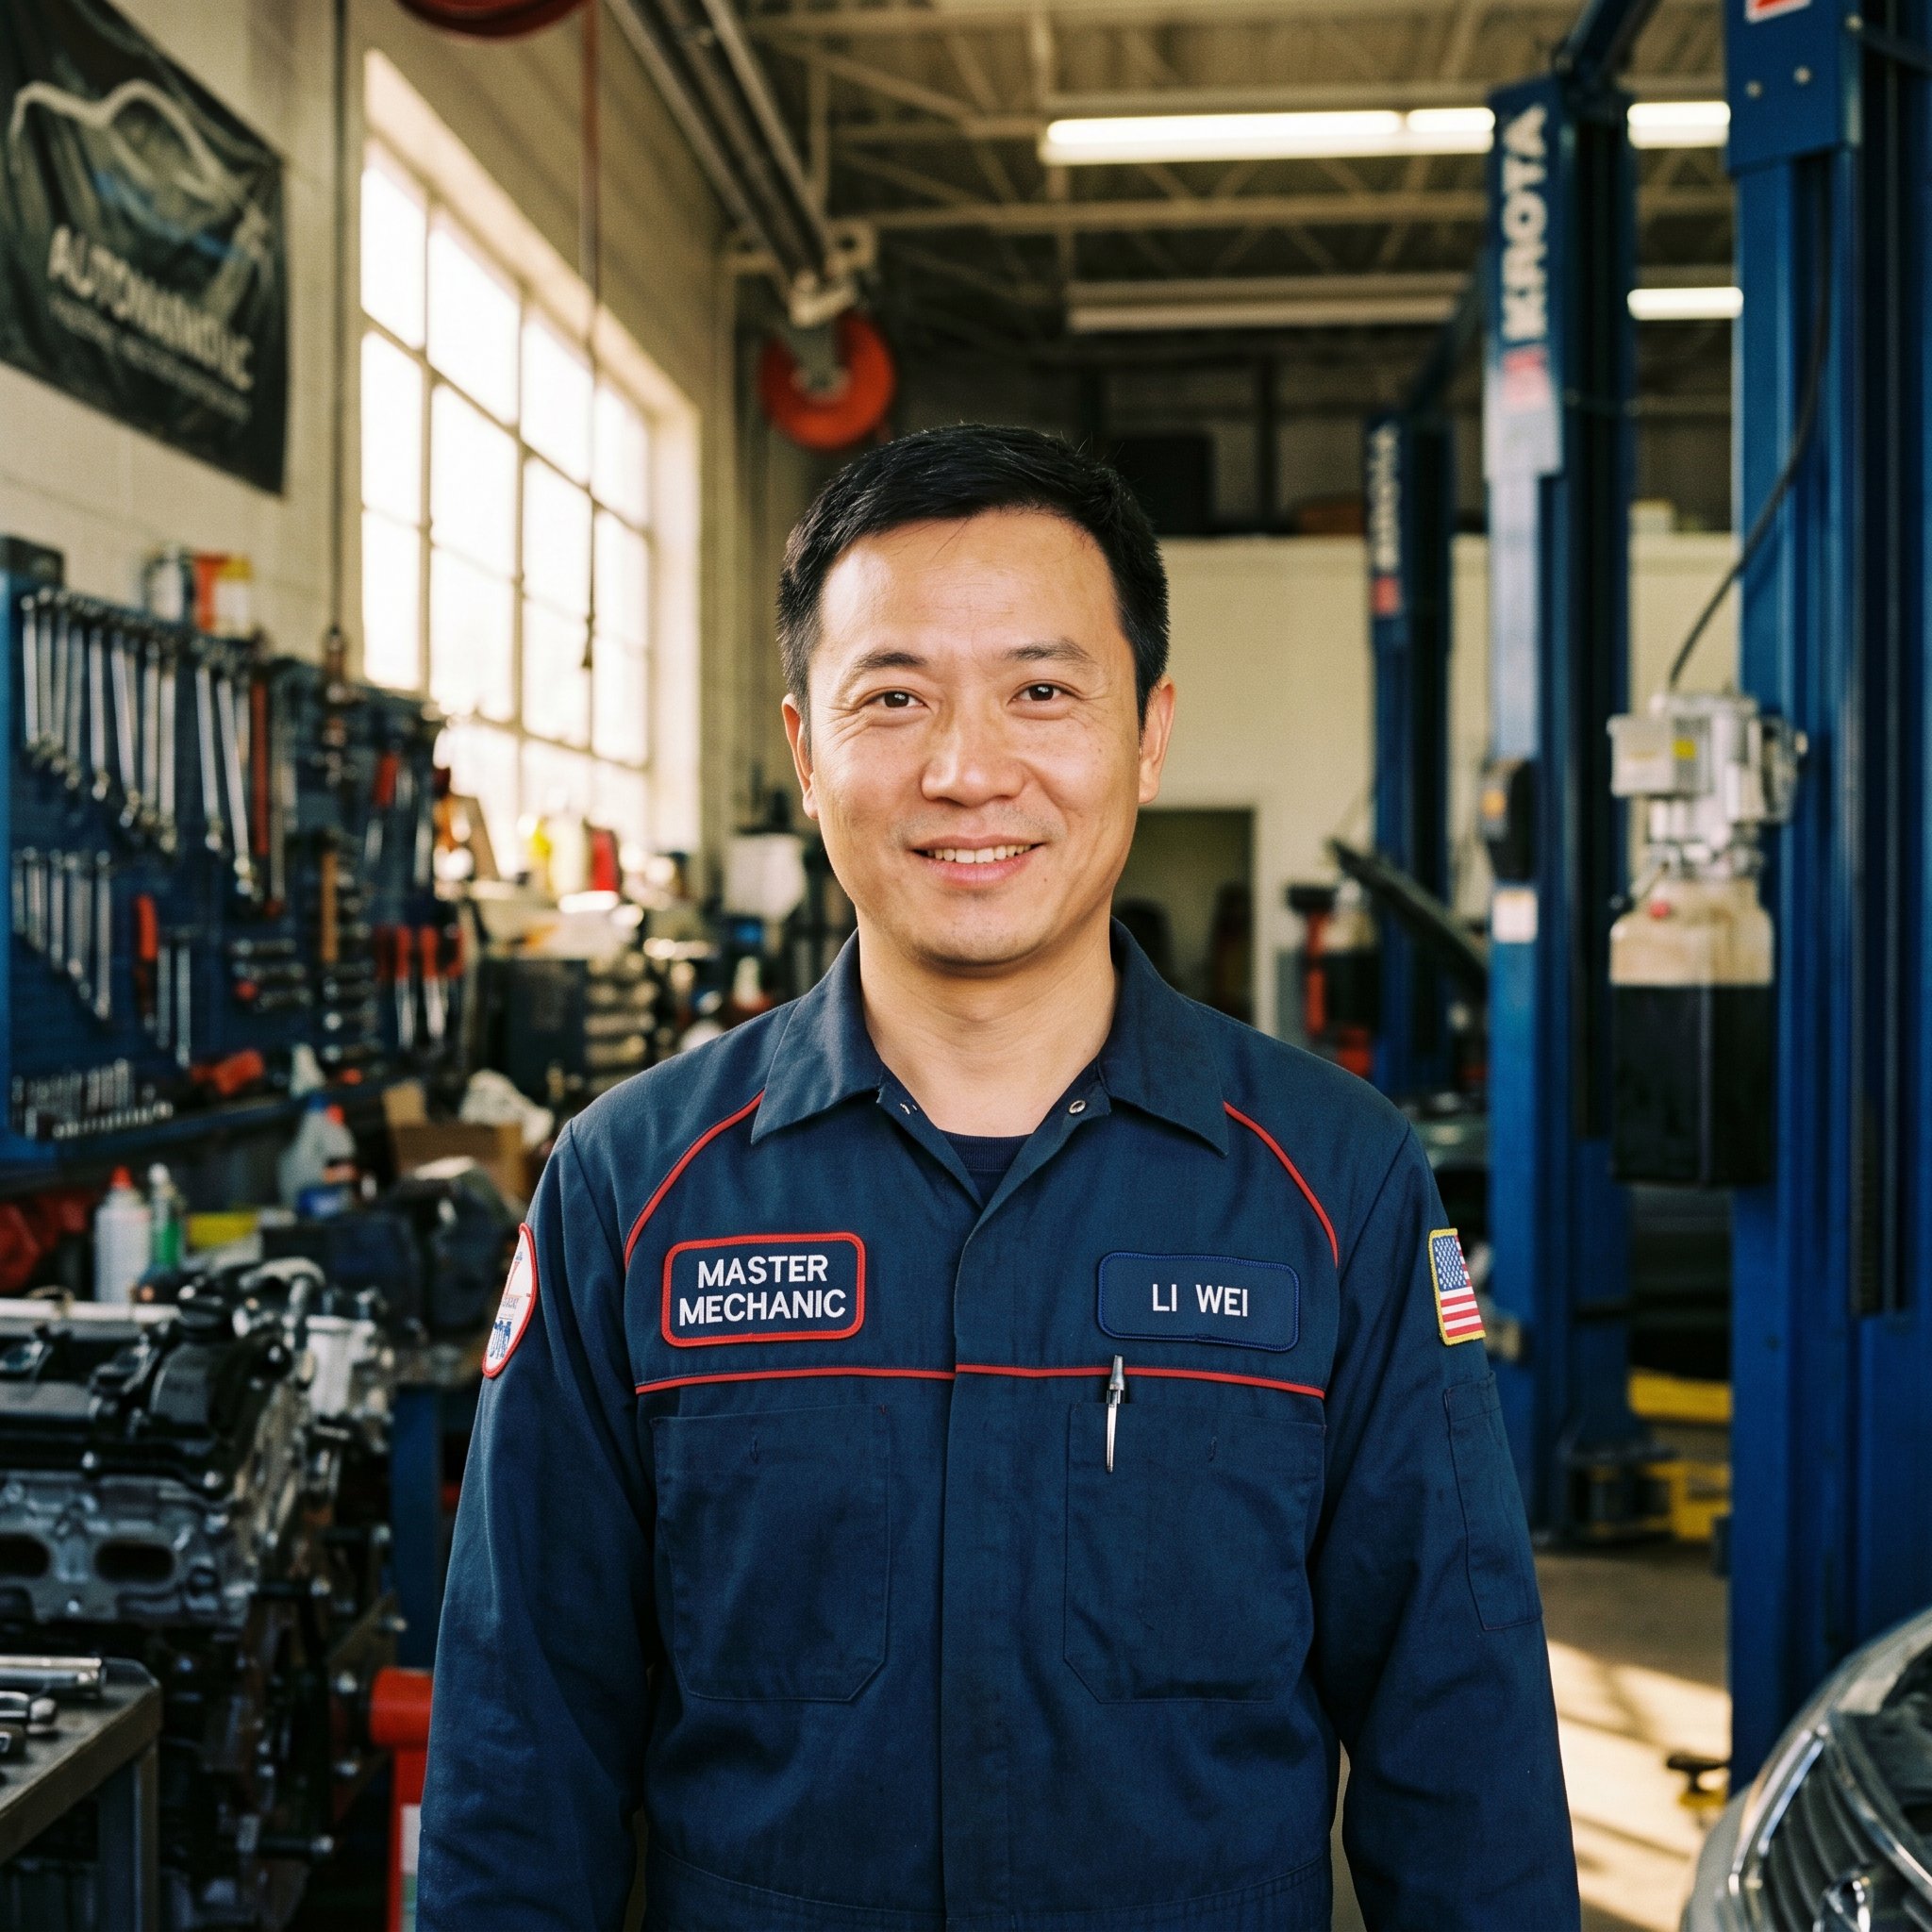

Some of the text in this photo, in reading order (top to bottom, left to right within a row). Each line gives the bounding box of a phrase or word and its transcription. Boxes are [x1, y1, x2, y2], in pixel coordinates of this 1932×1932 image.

[698, 1255, 828, 1289] MASTER
[678, 1289, 846, 1326] MECHANIC
[1152, 1283, 1248, 1317] LI WEI
